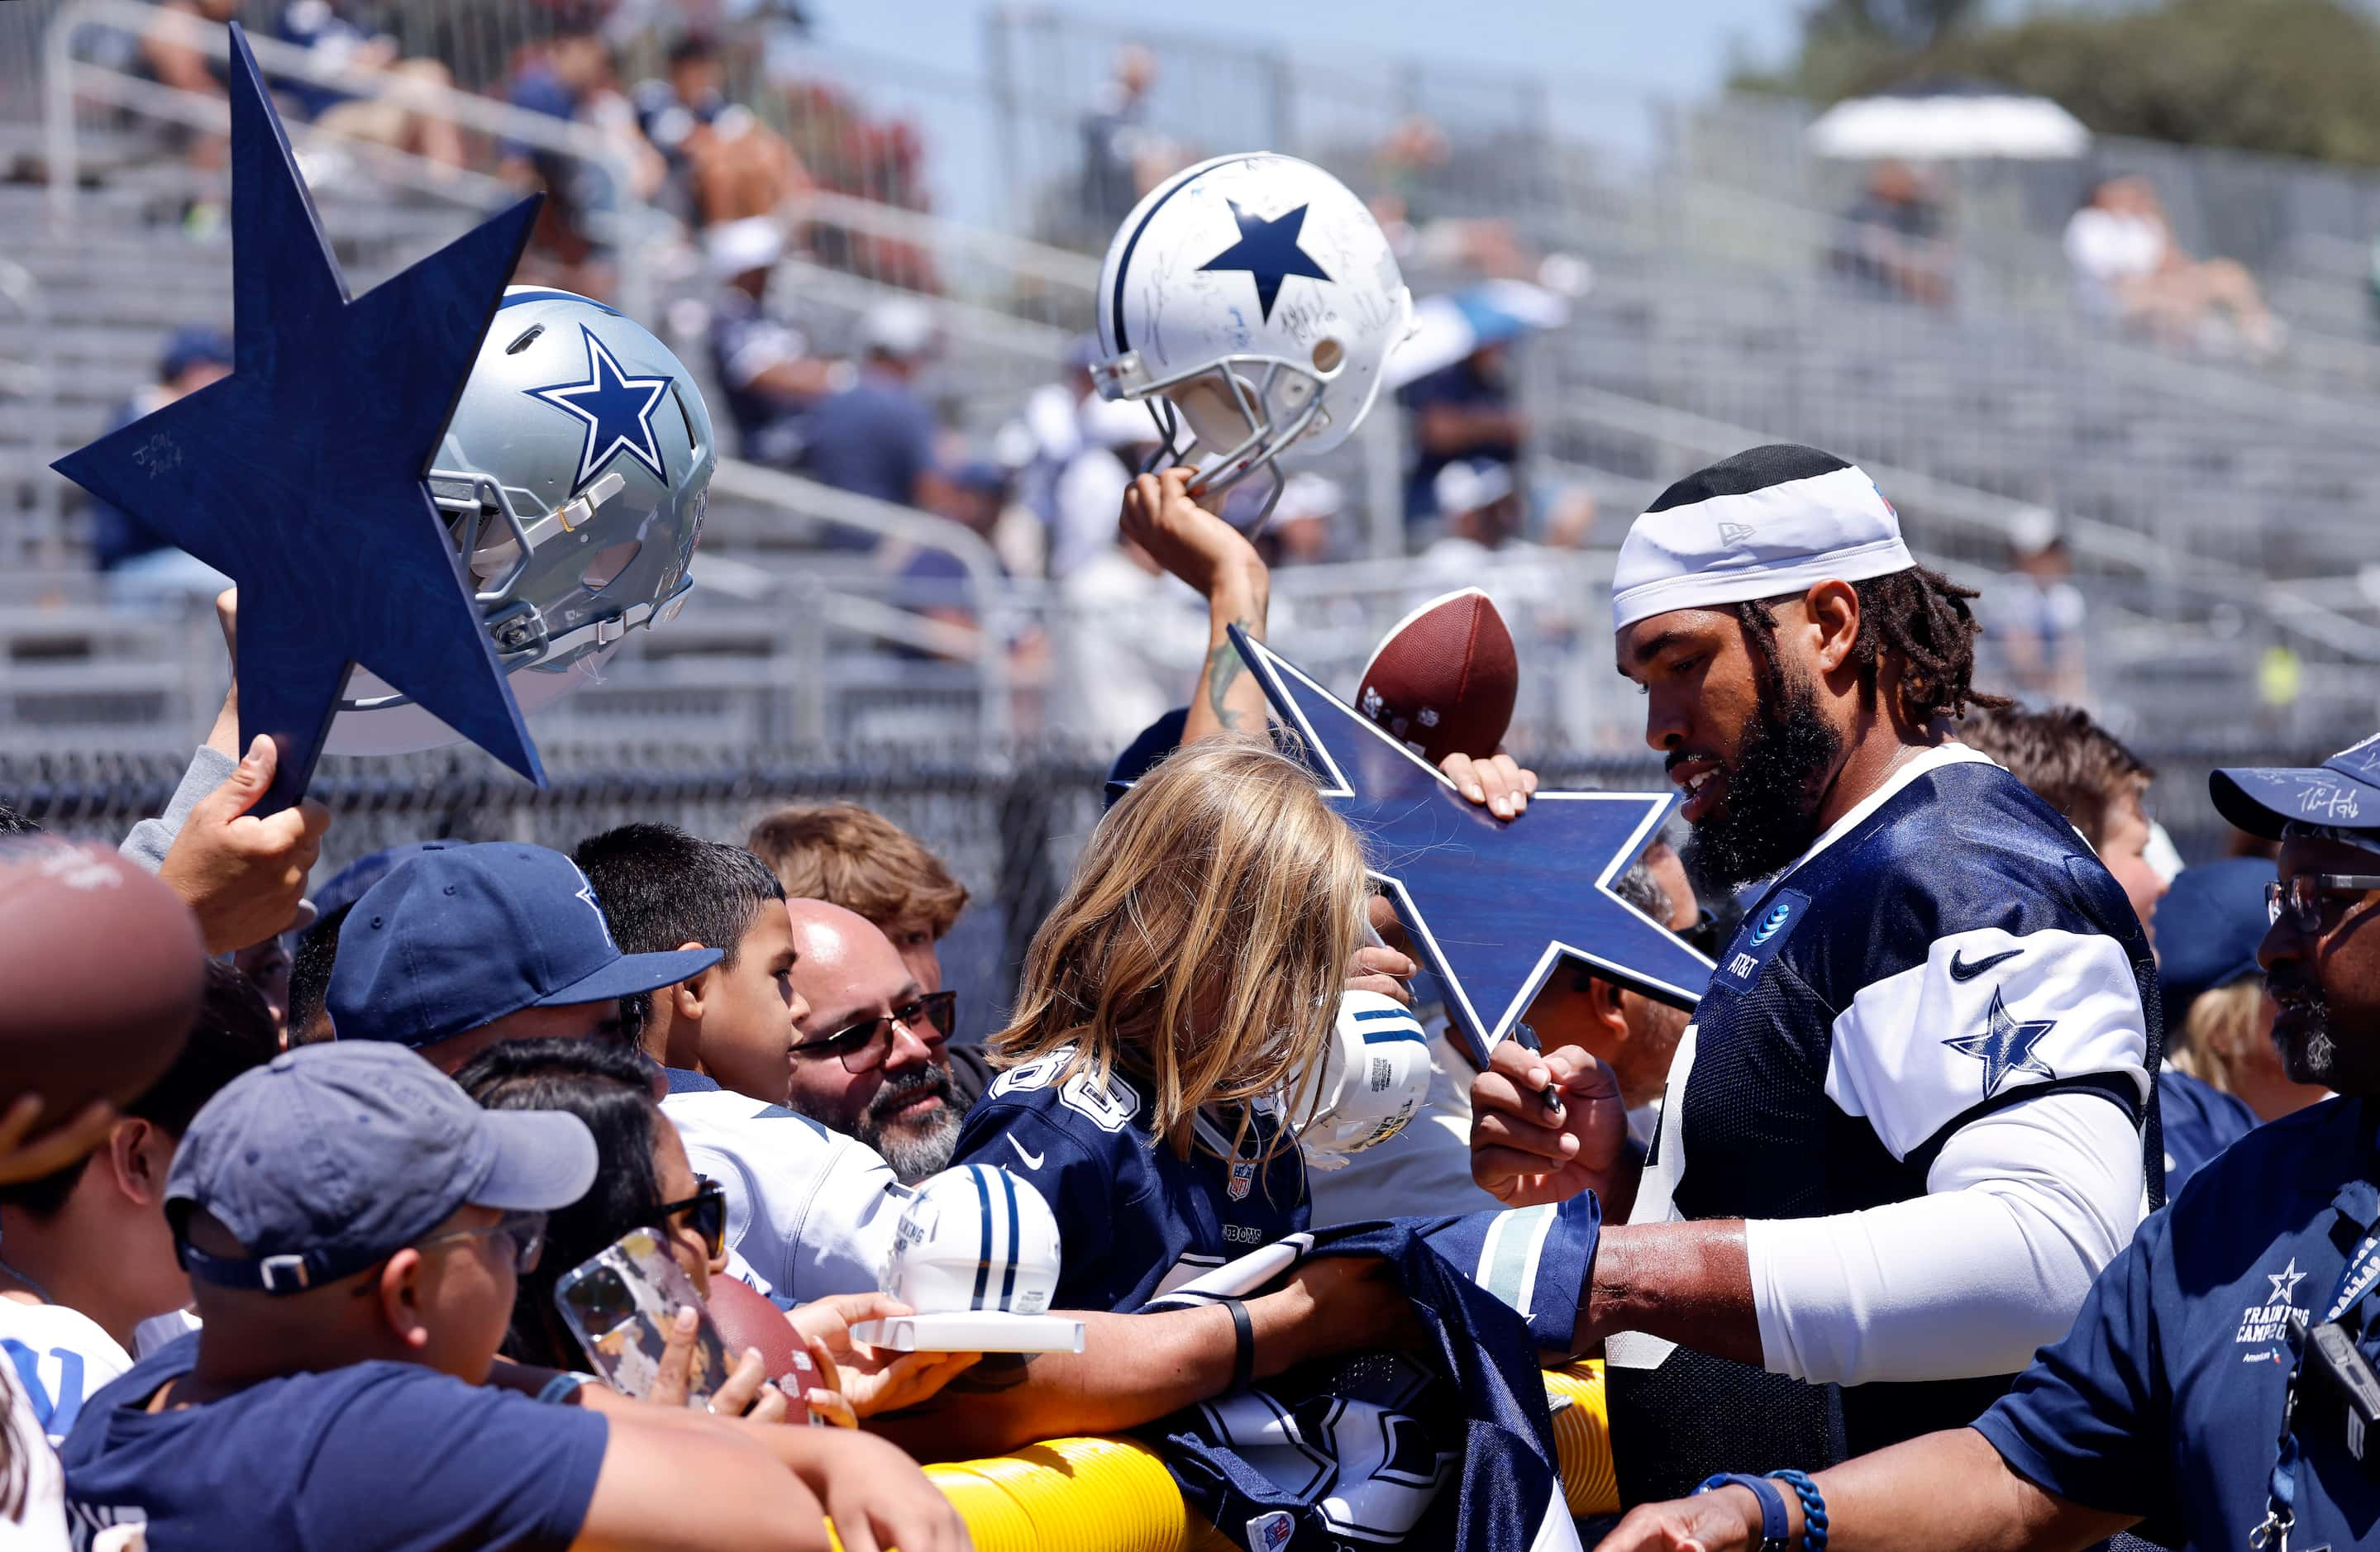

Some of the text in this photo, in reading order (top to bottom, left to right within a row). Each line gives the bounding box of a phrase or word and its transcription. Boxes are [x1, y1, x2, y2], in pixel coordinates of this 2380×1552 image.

[1727, 952, 1759, 979] AT&T
[2243, 1305, 2310, 1327] TRAINING
[2236, 1325, 2270, 1343] CAMP
